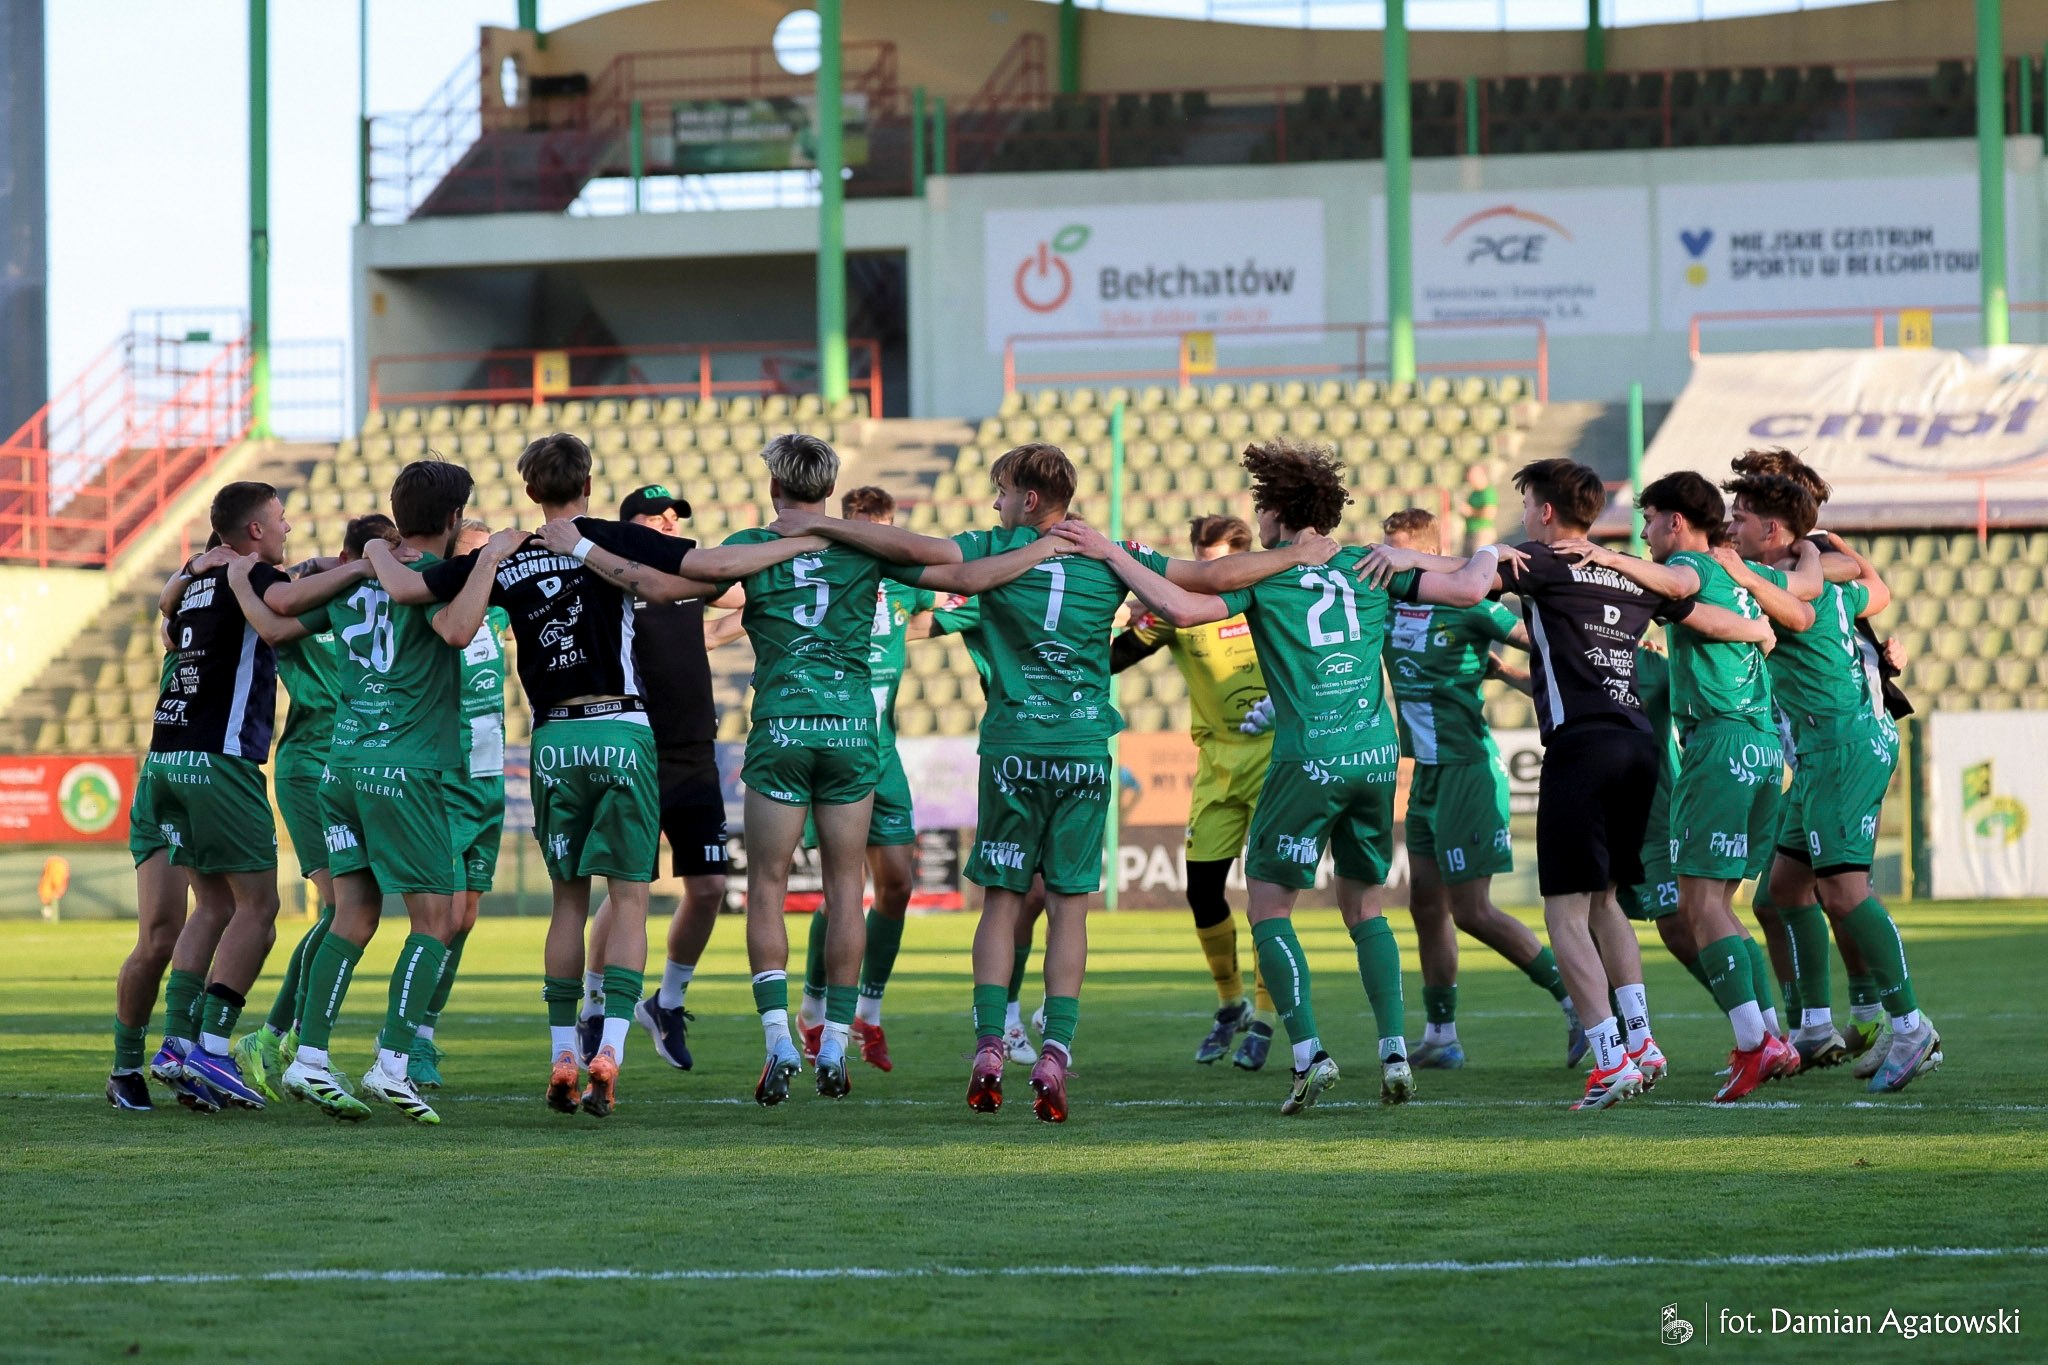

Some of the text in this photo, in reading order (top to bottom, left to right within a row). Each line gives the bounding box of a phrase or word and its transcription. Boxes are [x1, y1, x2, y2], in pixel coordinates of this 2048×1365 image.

[1730, 227, 1934, 251] MIEJSKIE CENTRUM
[1466, 235, 1547, 265] PGE
[1730, 256, 1813, 280] SPORTU
[1820, 255, 1840, 277] W
[1099, 256, 1296, 301] Bełchatów
[1749, 397, 2037, 448] cmpl
[793, 557, 829, 627] 5
[1033, 562, 1066, 632] 7
[1299, 569, 1361, 648] 21
[1038, 650, 1069, 663] PGE
[1609, 648, 1633, 660] TWÓJ
[1609, 658, 1634, 669] TRZEC
[1326, 661, 1354, 676] PGE
[475, 677, 496, 692] PGE
[1311, 680, 1340, 691] Górnictwo
[827, 738, 868, 748] GALERIA
[147, 750, 213, 768] LIMPIA
[539, 744, 638, 771] OLIMPIA
[1742, 743, 1783, 769] OLIMP
[167, 772, 211, 785] GALERIA
[1002, 755, 1105, 785] OLIMPIA
[355, 780, 404, 799] GALERIA
[769, 790, 793, 800] SKLEP
[328, 824, 348, 836] SKLEP
[997, 841, 1020, 851] SKLEP
[1724, 839, 1748, 858] TM
[1809, 830, 1822, 857] 9
[1446, 846, 1467, 873] 19
[1656, 880, 1680, 907] 25
